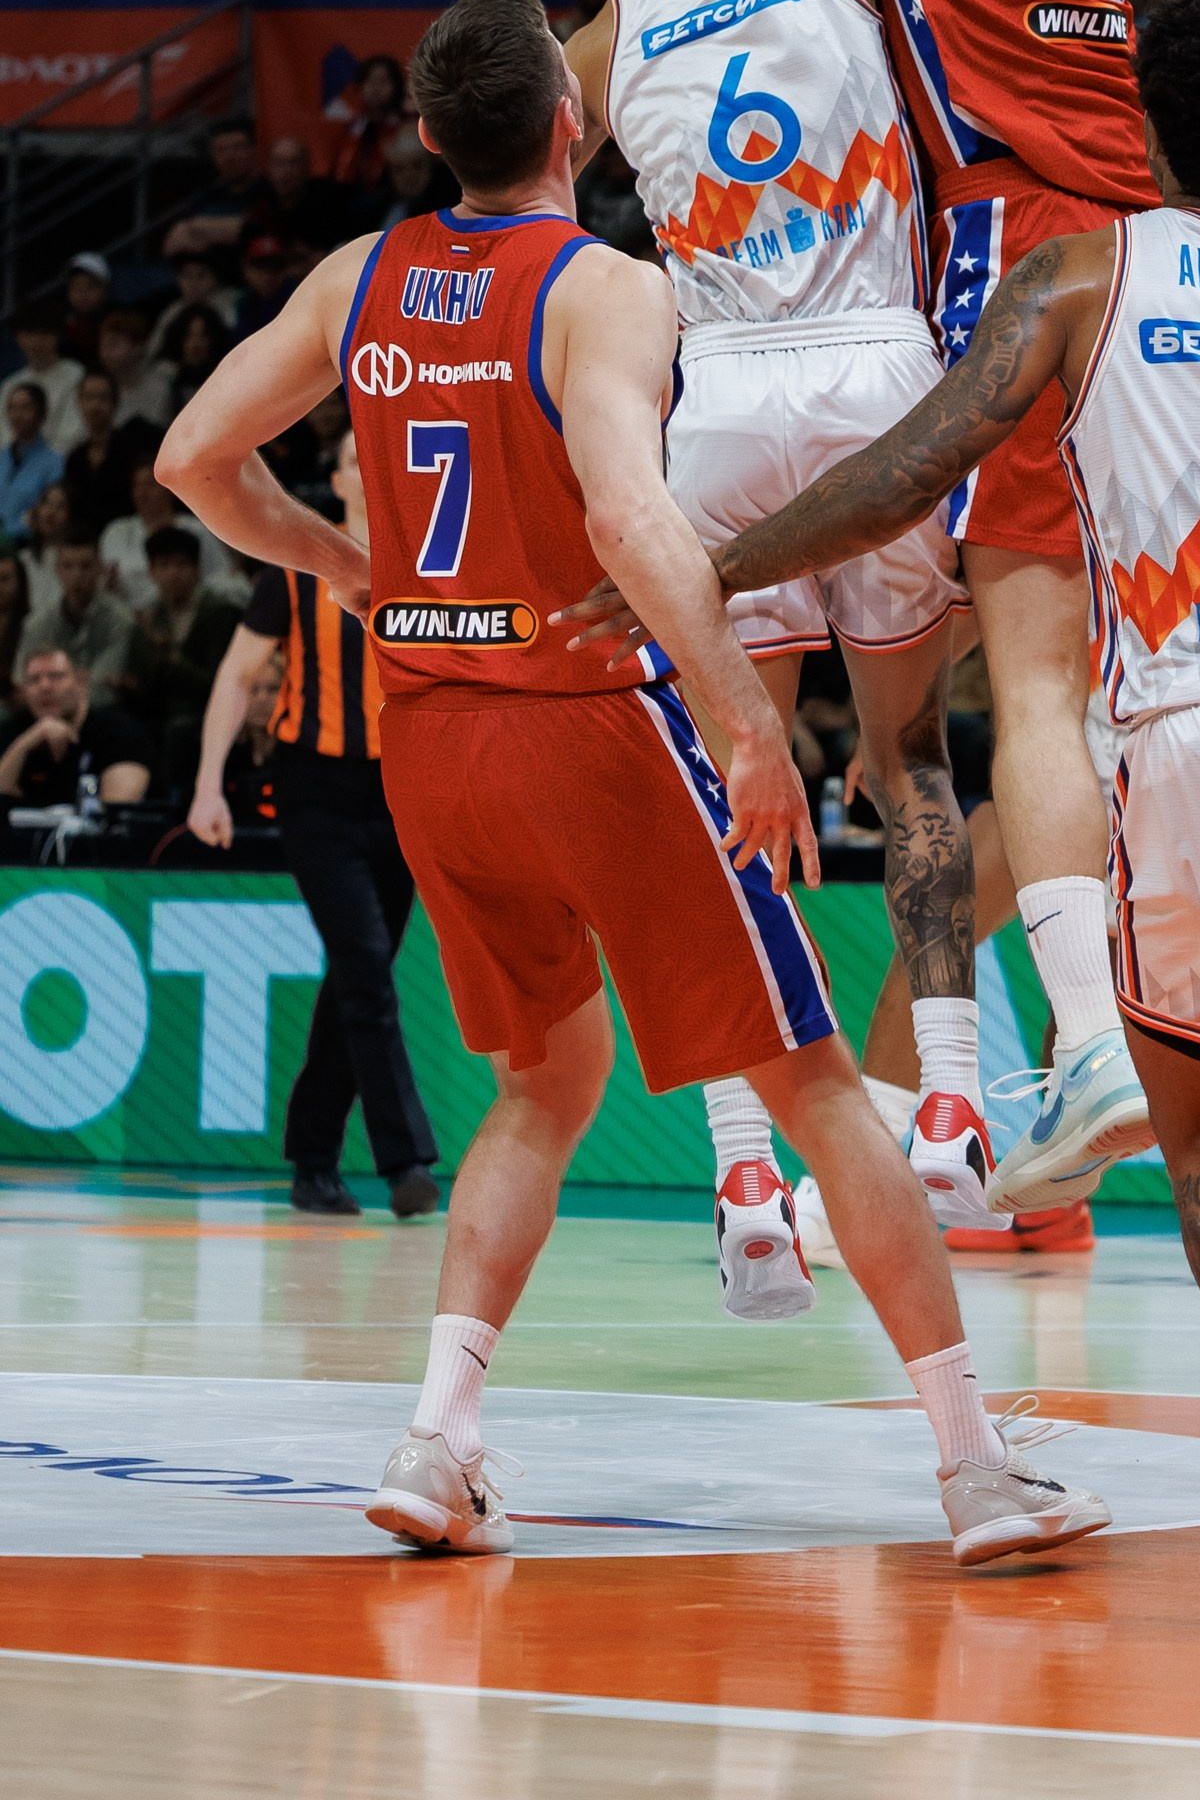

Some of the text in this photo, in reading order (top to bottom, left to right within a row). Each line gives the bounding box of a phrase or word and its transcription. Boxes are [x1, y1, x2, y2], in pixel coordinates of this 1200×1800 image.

[1038, 8, 1128, 39] WINLINE
[707, 51, 802, 183] 6
[400, 266, 496, 325] UKHV
[406, 419, 472, 578] 7
[386, 608, 507, 638] WINLINE
